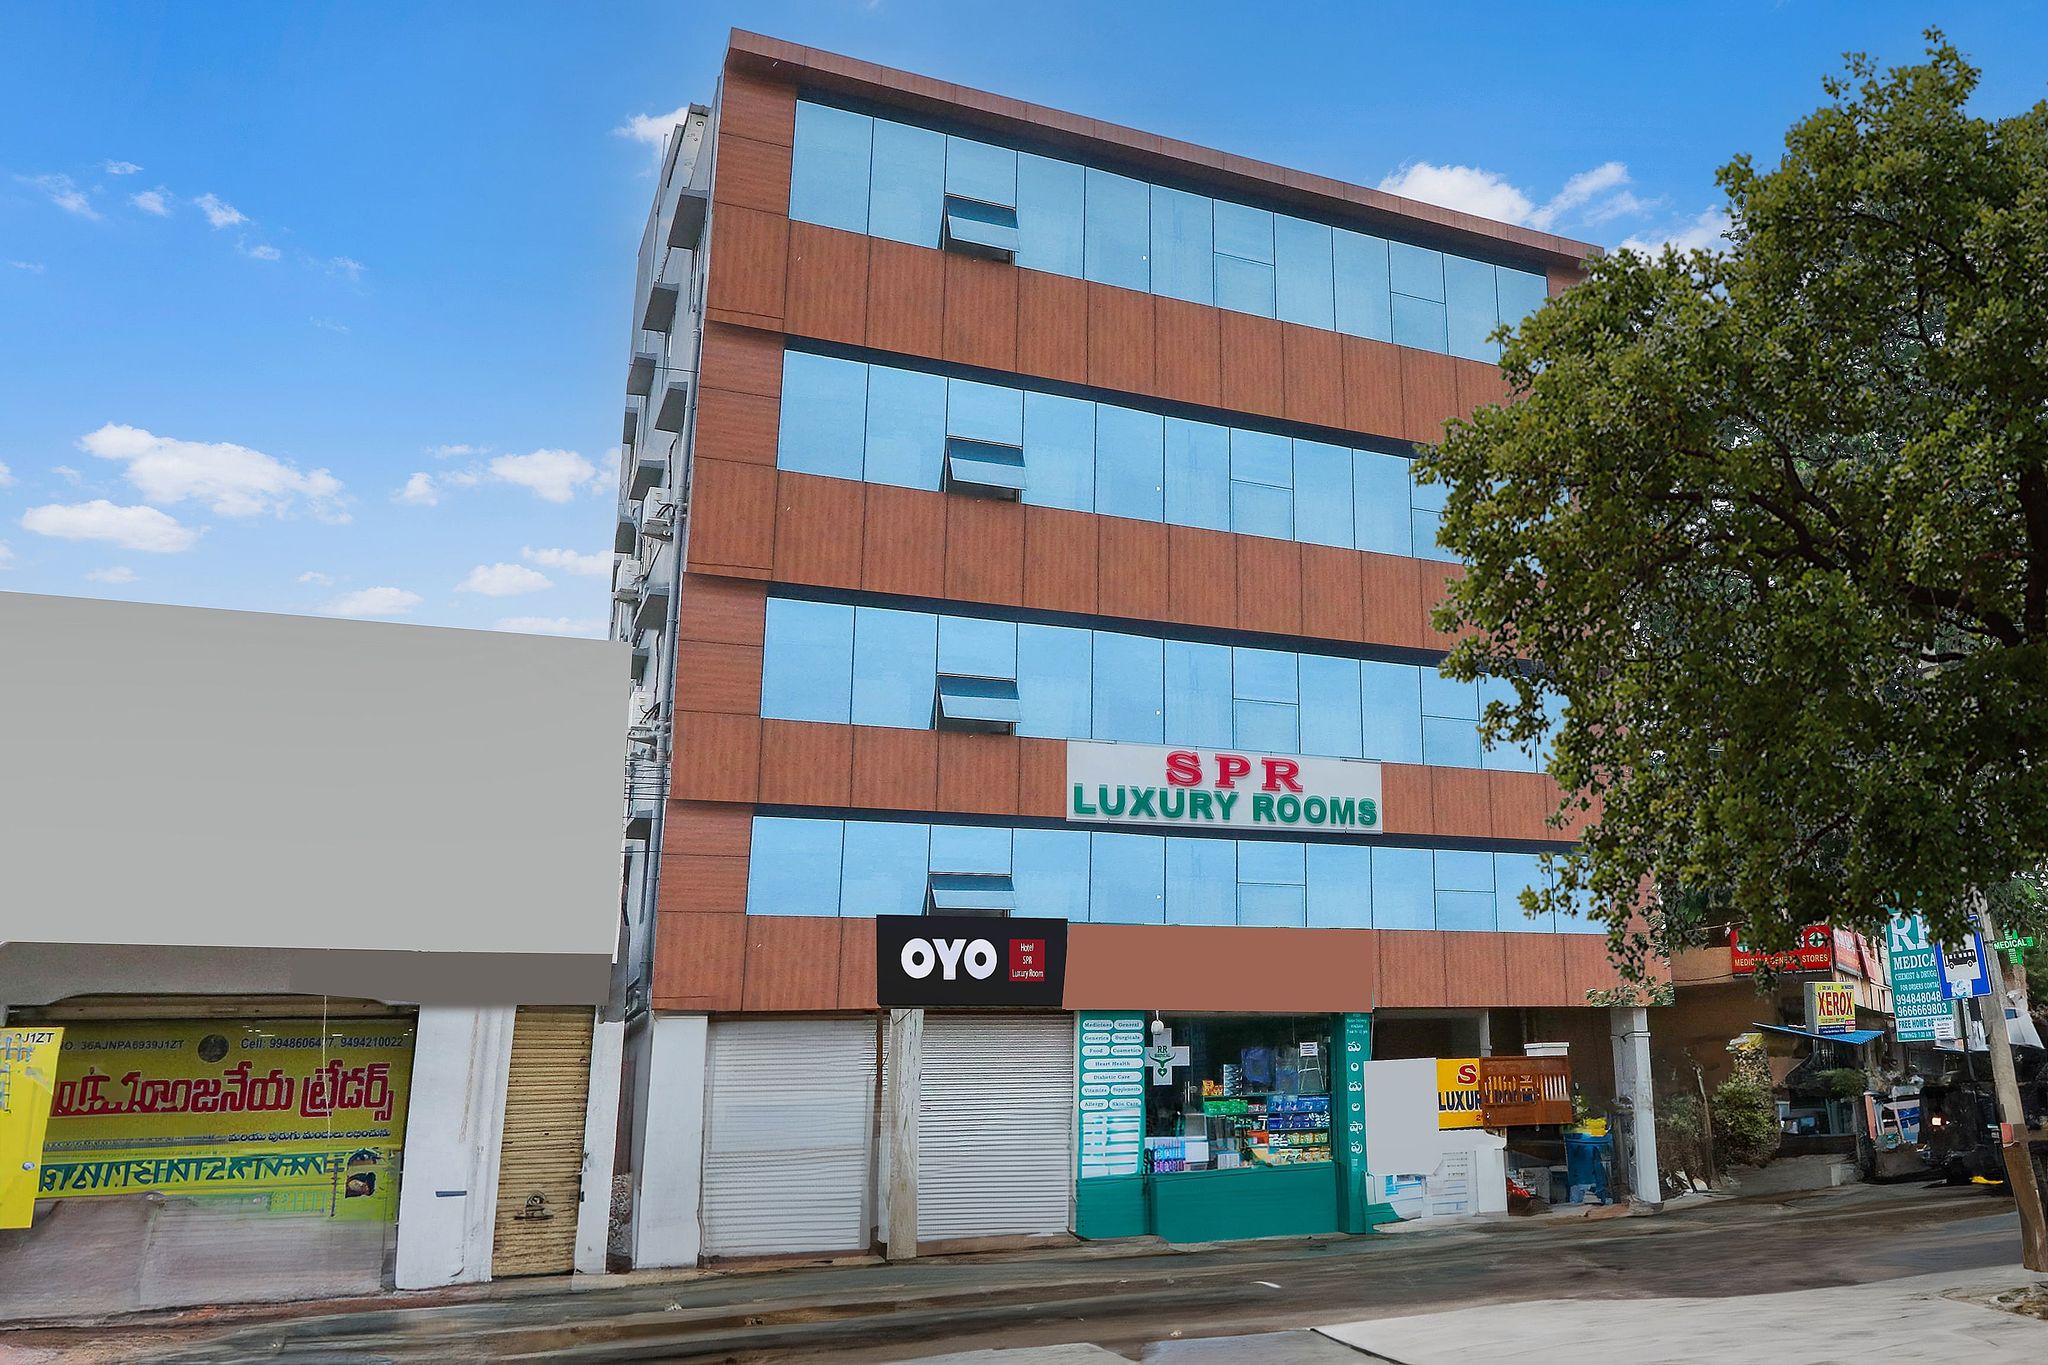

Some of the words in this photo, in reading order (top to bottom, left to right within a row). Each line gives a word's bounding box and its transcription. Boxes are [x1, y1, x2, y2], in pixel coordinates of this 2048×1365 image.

[1166, 750, 1304, 792] SPR
[1073, 782, 1239, 820] LUXURY
[1252, 792, 1378, 826] ROOMS
[1020, 943, 1035, 952] Hotel
[1993, 938, 2027, 950] MEDICAL
[901, 938, 997, 980] OYO
[1022, 955, 1033, 965] SPR
[1802, 953, 1828, 963] STORES
[1012, 968, 1029, 979] Luxury
[1029, 968, 1044, 978] Room
[1818, 991, 1853, 1016] XEROX
[1897, 1002, 1947, 1017] 9666669803
[1898, 1019, 1911, 1028] FREE
[1912, 1019, 1927, 1028] HOME
[240, 1038, 266, 1049] Cell:
[340, 1037, 404, 1048] 9494210022
[1157, 1045, 1168, 1054] RR
[1457, 1064, 1478, 1085] S
